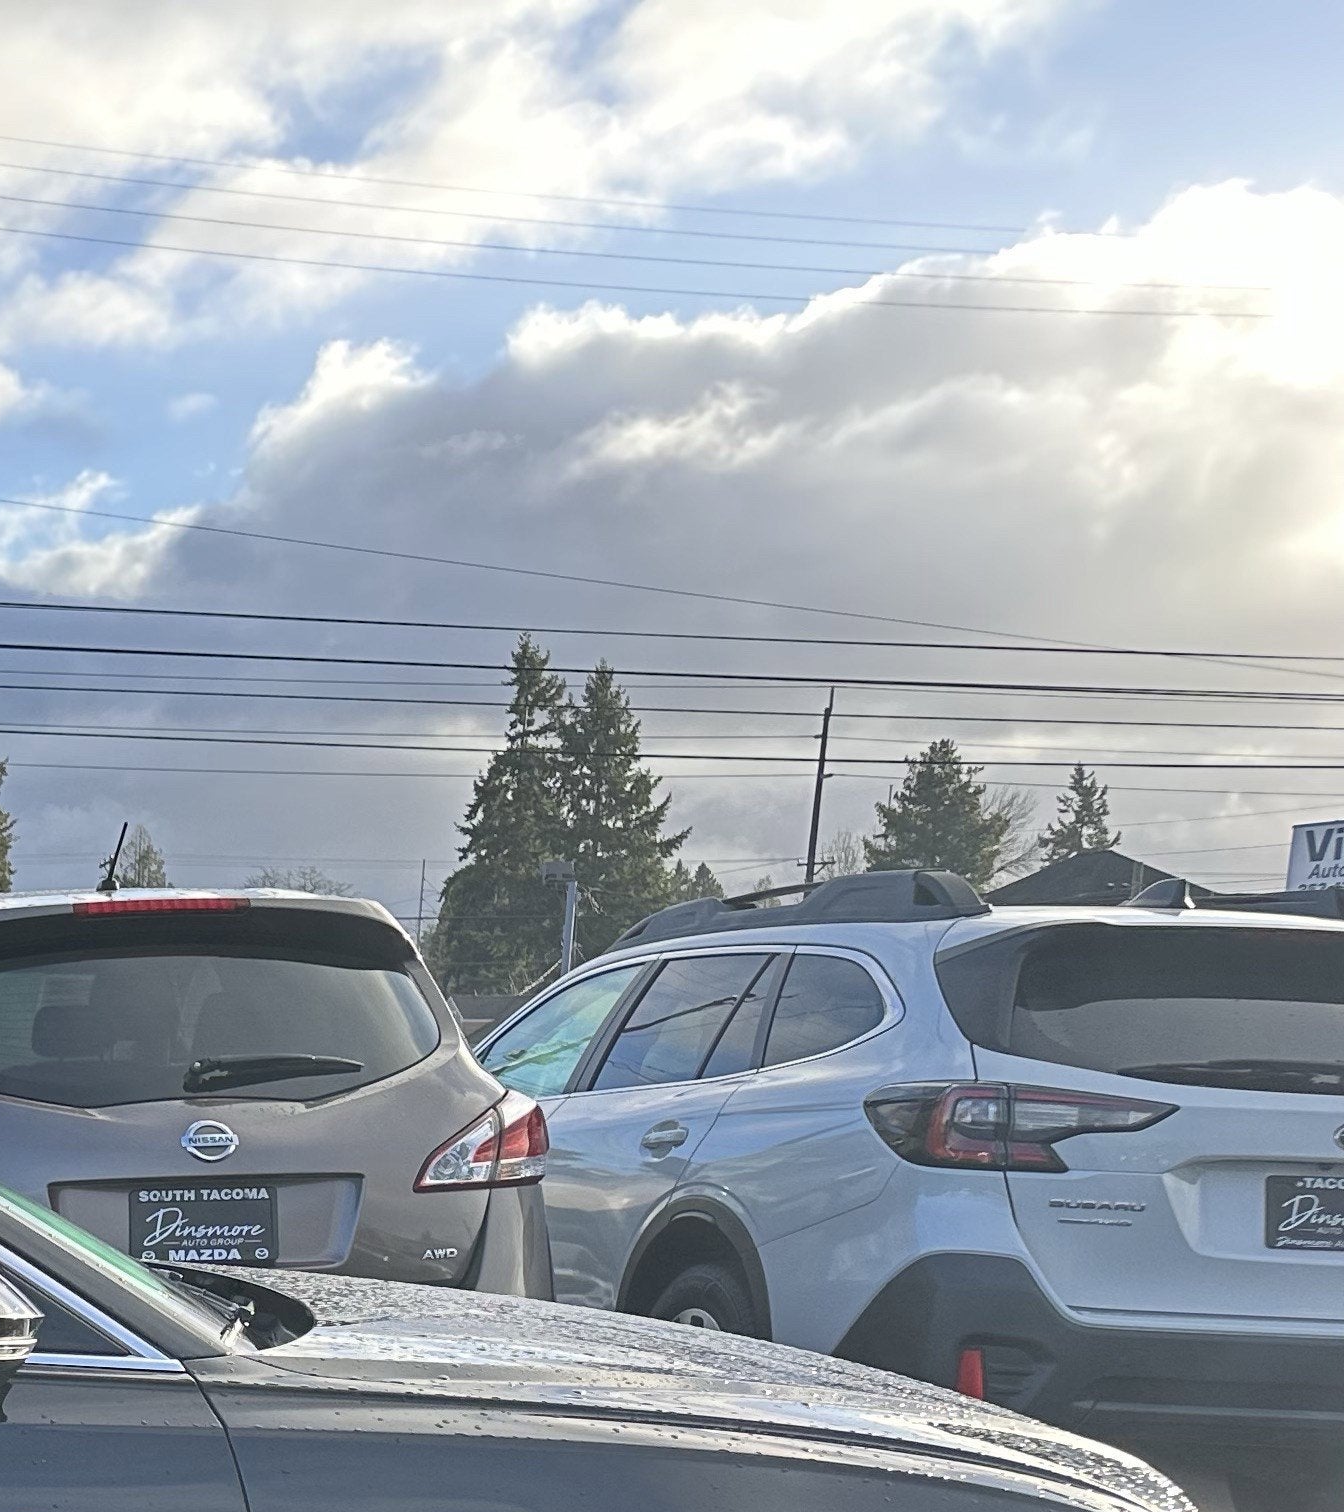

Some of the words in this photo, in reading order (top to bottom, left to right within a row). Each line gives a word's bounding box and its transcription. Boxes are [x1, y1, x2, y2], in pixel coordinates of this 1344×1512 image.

[188, 1136, 234, 1144] NISSAN
[138, 1189, 196, 1202] SOUTH
[200, 1187, 269, 1200] TACOMA
[1049, 1199, 1146, 1212] SUBARU
[143, 1207, 265, 1247] Dinsmore
[181, 1239, 208, 1247] AUTO
[210, 1238, 244, 1246] GROUP
[168, 1249, 241, 1262] MAZDA
[422, 1248, 458, 1260] AWD
